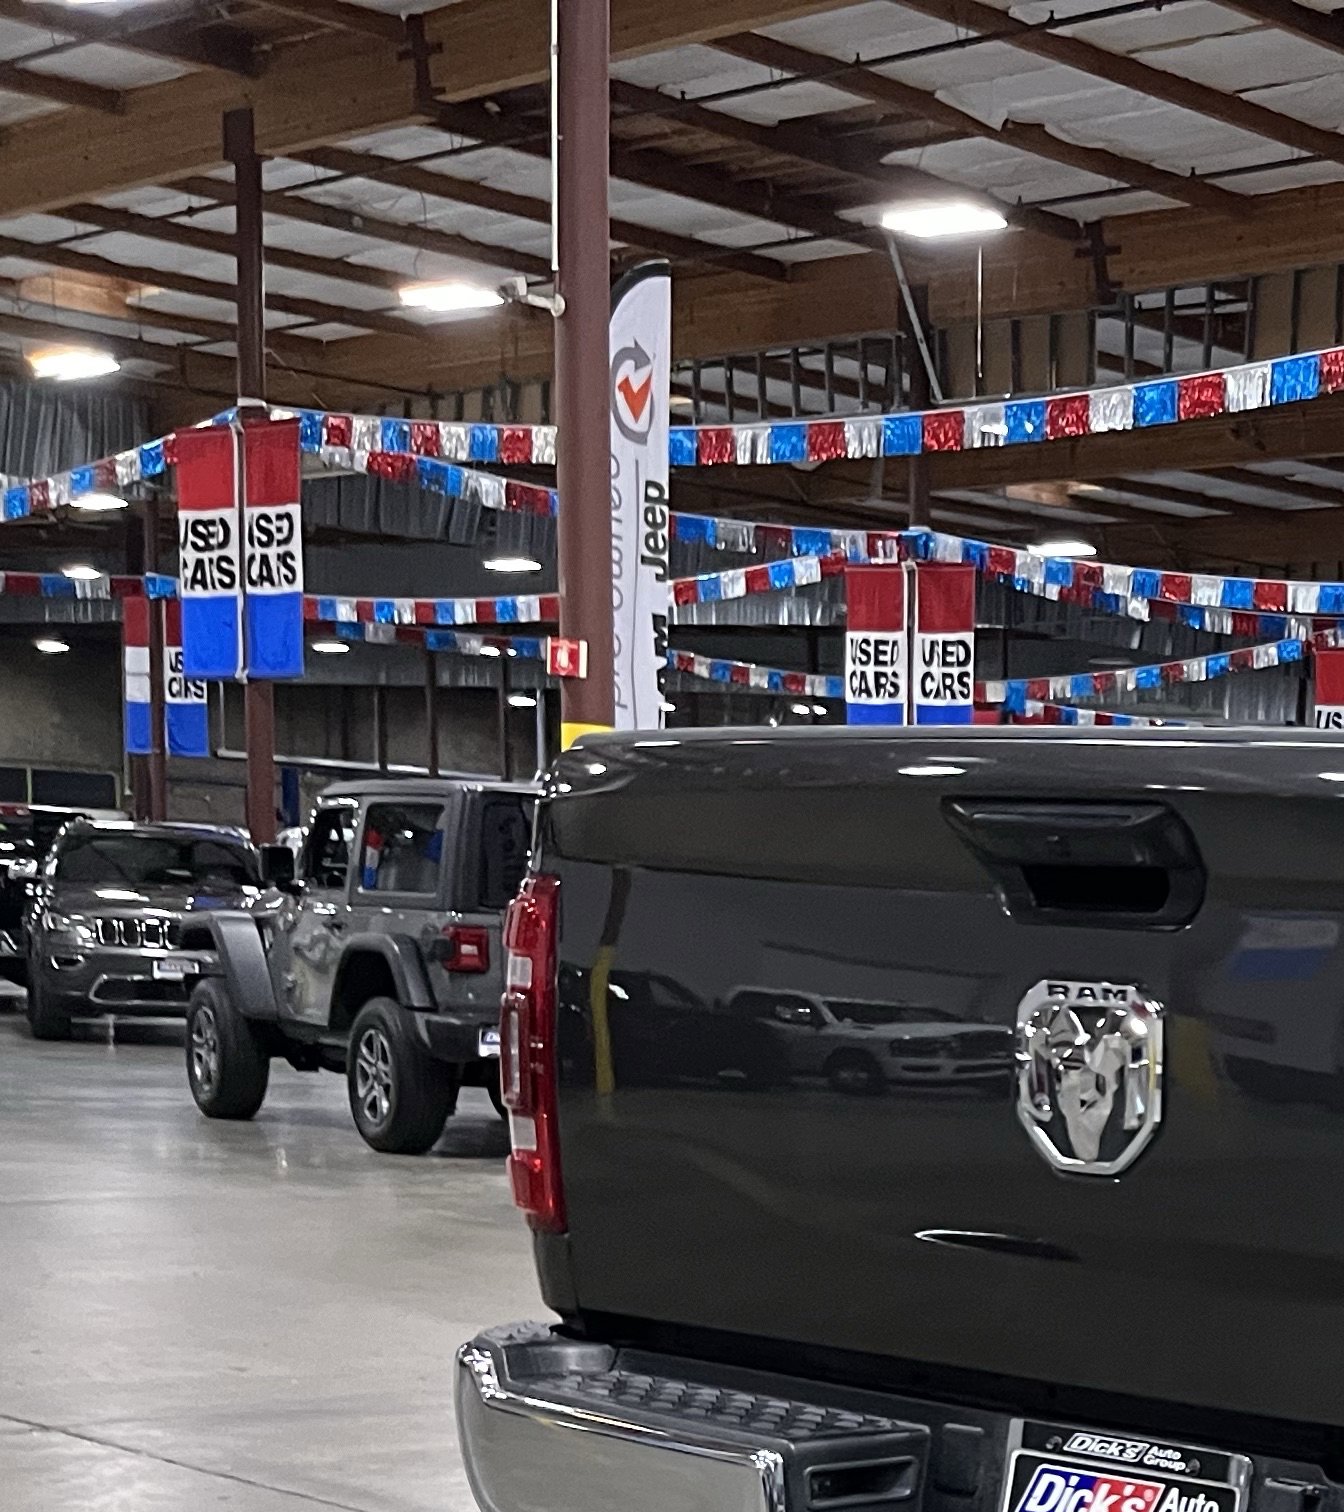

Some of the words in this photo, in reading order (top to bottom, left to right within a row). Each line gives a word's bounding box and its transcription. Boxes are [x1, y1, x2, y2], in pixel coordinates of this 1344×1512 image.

[640, 480, 669, 583] Jeep
[182, 555, 236, 590] AS
[850, 638, 900, 667] USED
[849, 670, 900, 699] CARS
[1047, 984, 1128, 1001] RAM
[1143, 1455, 1187, 1472] Group
[1148, 1446, 1181, 1460] Auto
